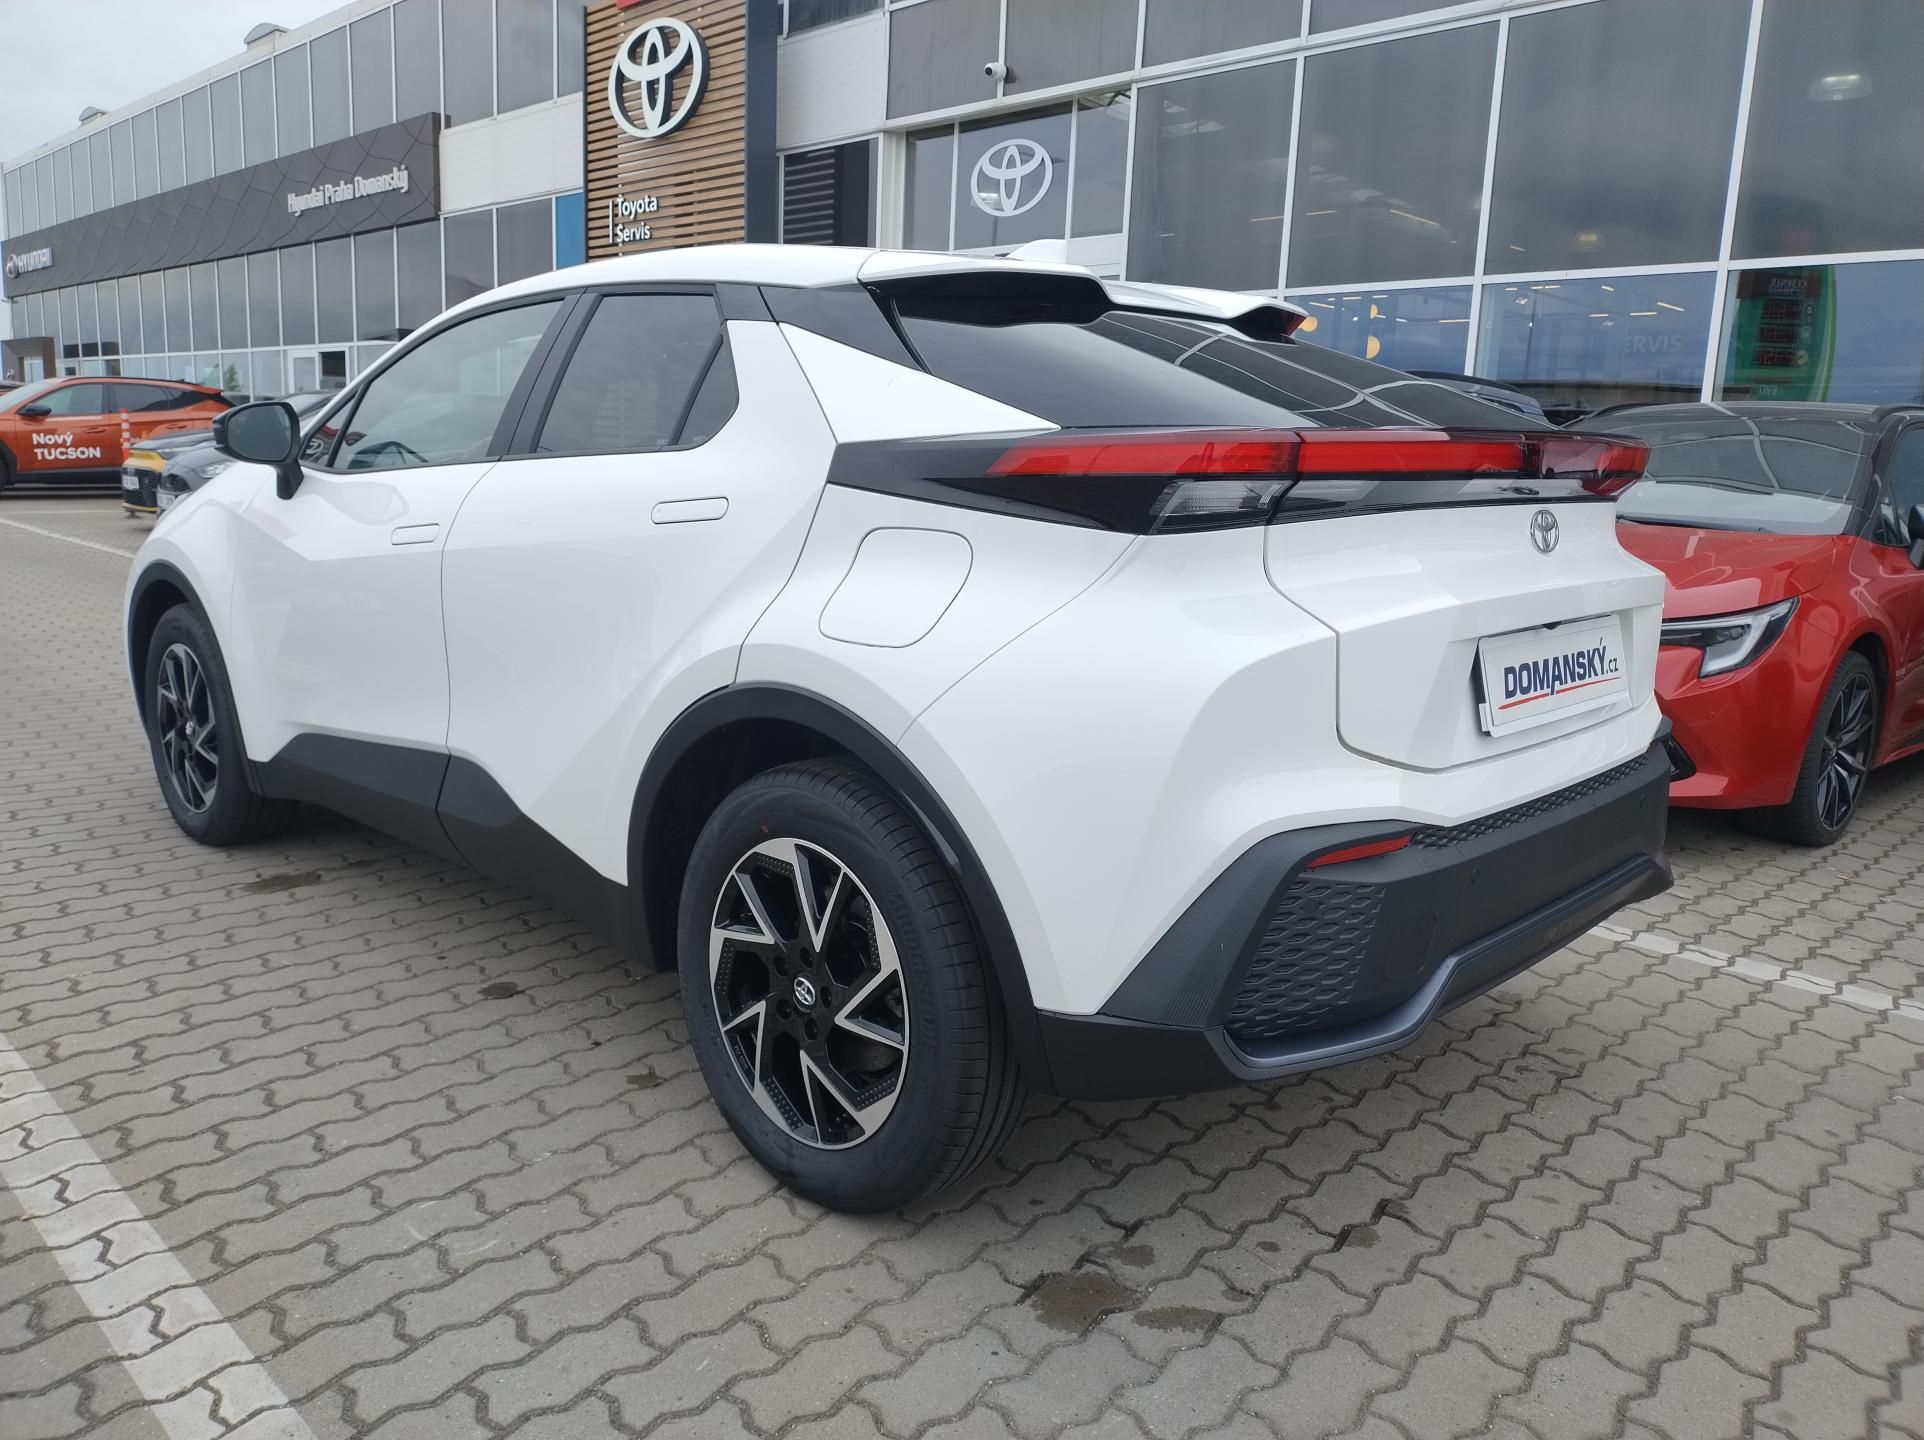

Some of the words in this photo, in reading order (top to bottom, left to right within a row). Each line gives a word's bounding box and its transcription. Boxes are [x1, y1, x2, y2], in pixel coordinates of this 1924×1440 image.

[287, 185, 325, 217] Hyundai
[325, 183, 354, 205] Praha
[354, 164, 409, 198] Domanský
[616, 194, 658, 220] Toyota
[616, 221, 651, 243] Servis
[32, 431, 73, 447] Nový
[33, 446, 101, 461] TUCSON
[1503, 636, 1619, 700] DOMANSKÝ.cz
